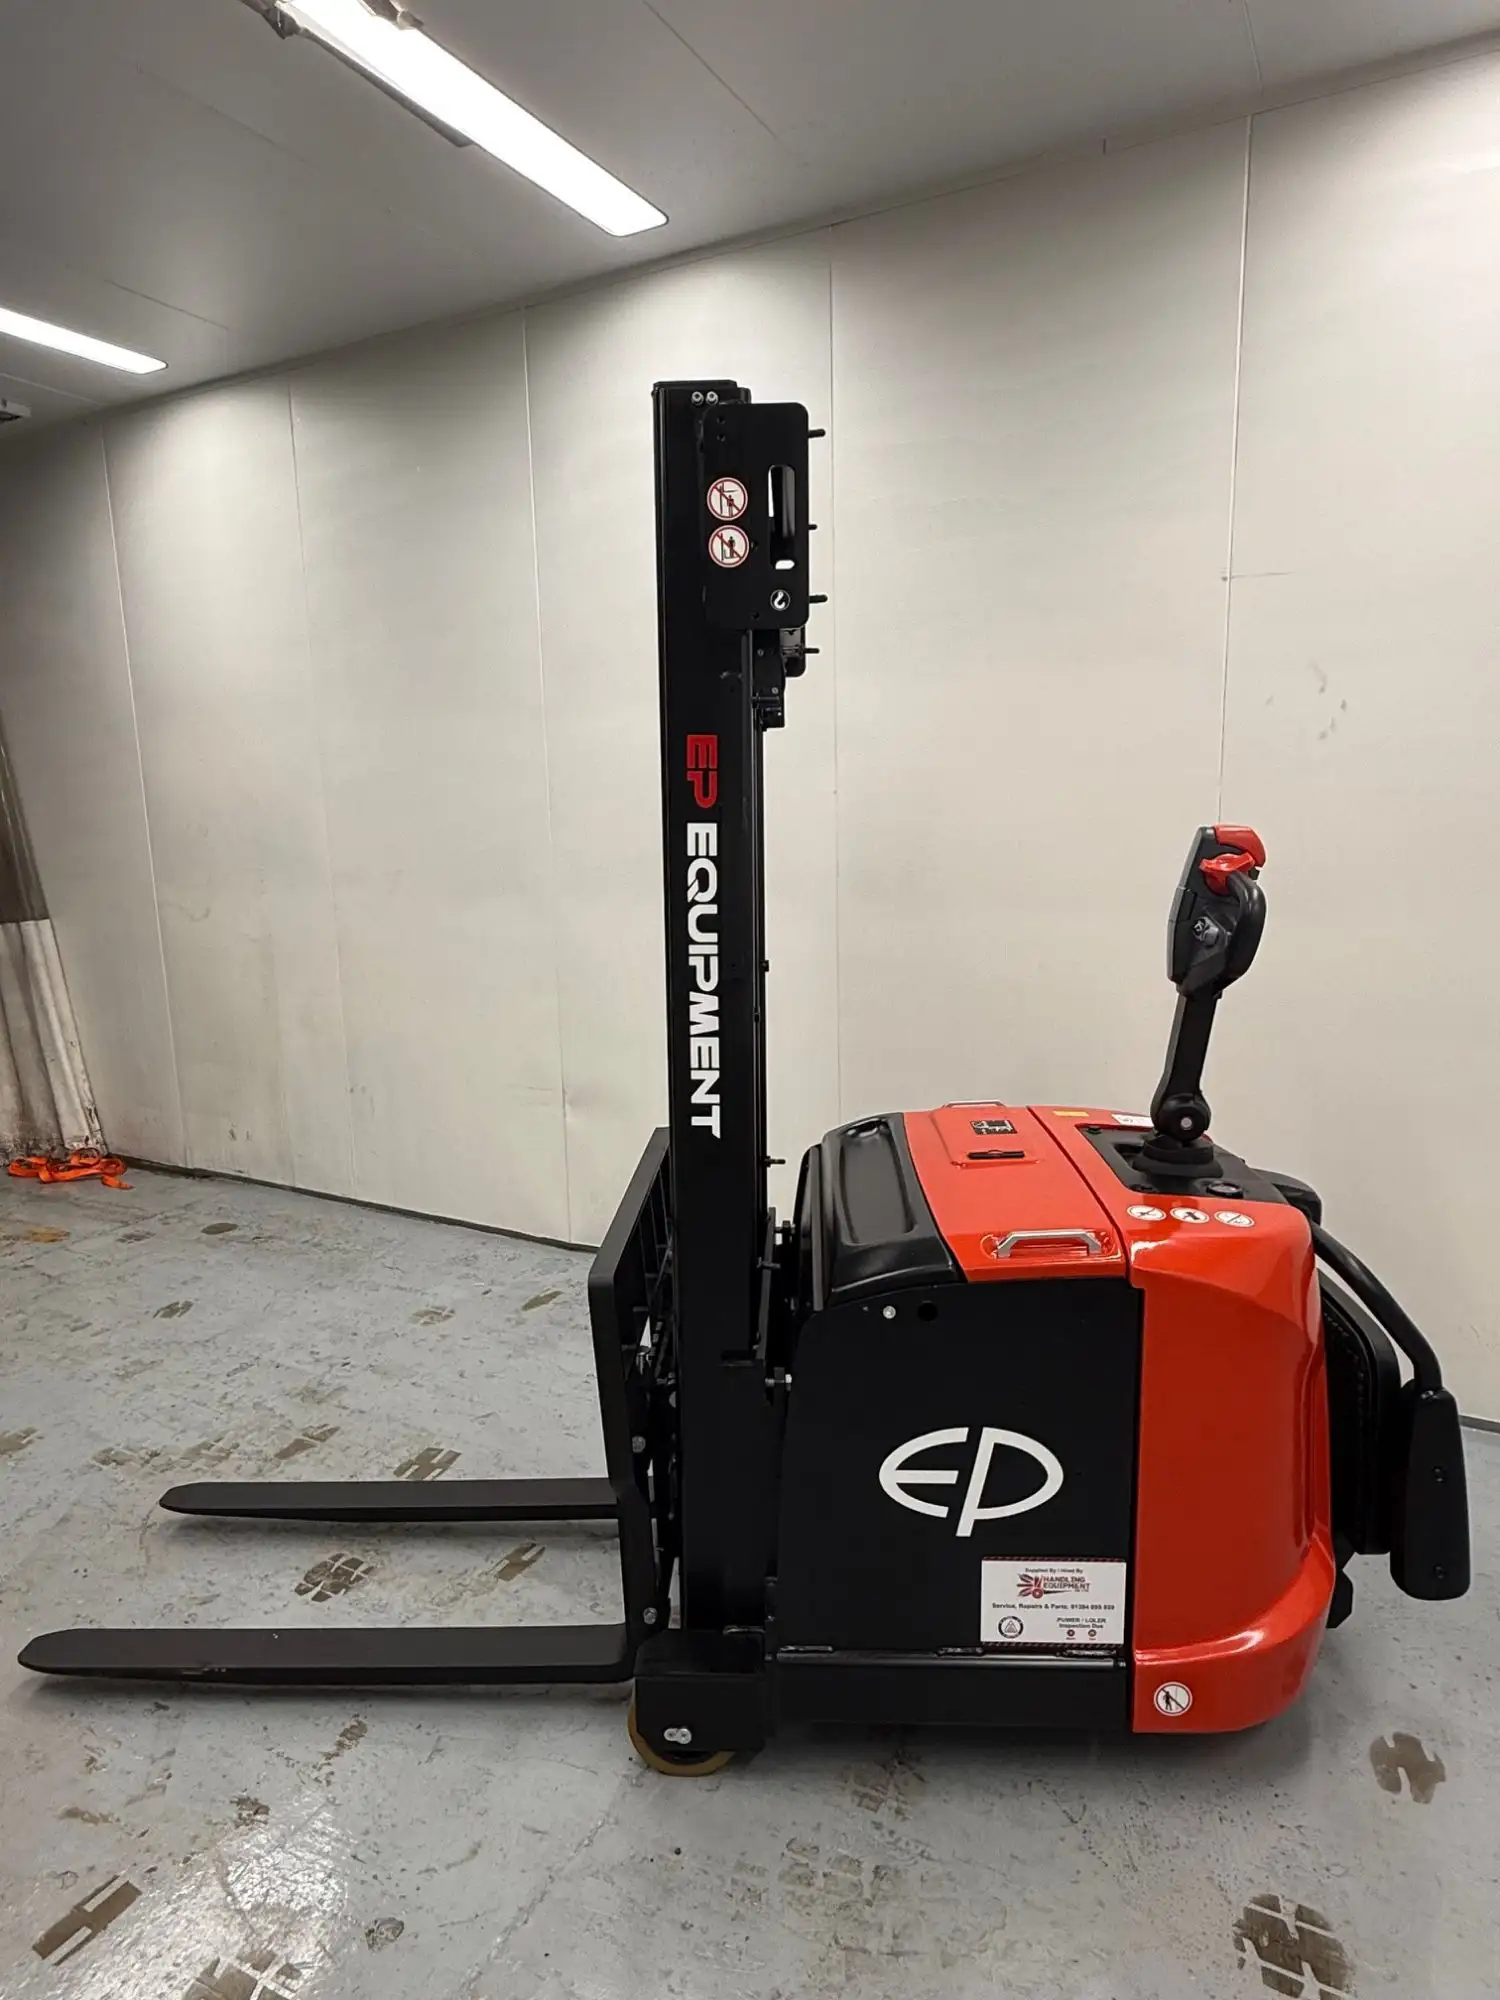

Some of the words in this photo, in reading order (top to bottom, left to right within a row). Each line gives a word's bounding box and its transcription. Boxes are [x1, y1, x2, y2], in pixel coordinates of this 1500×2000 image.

[686, 734, 718, 809] EP
[686, 822, 721, 1140] EQUIPMENT
[878, 1427, 1064, 1537] EP
